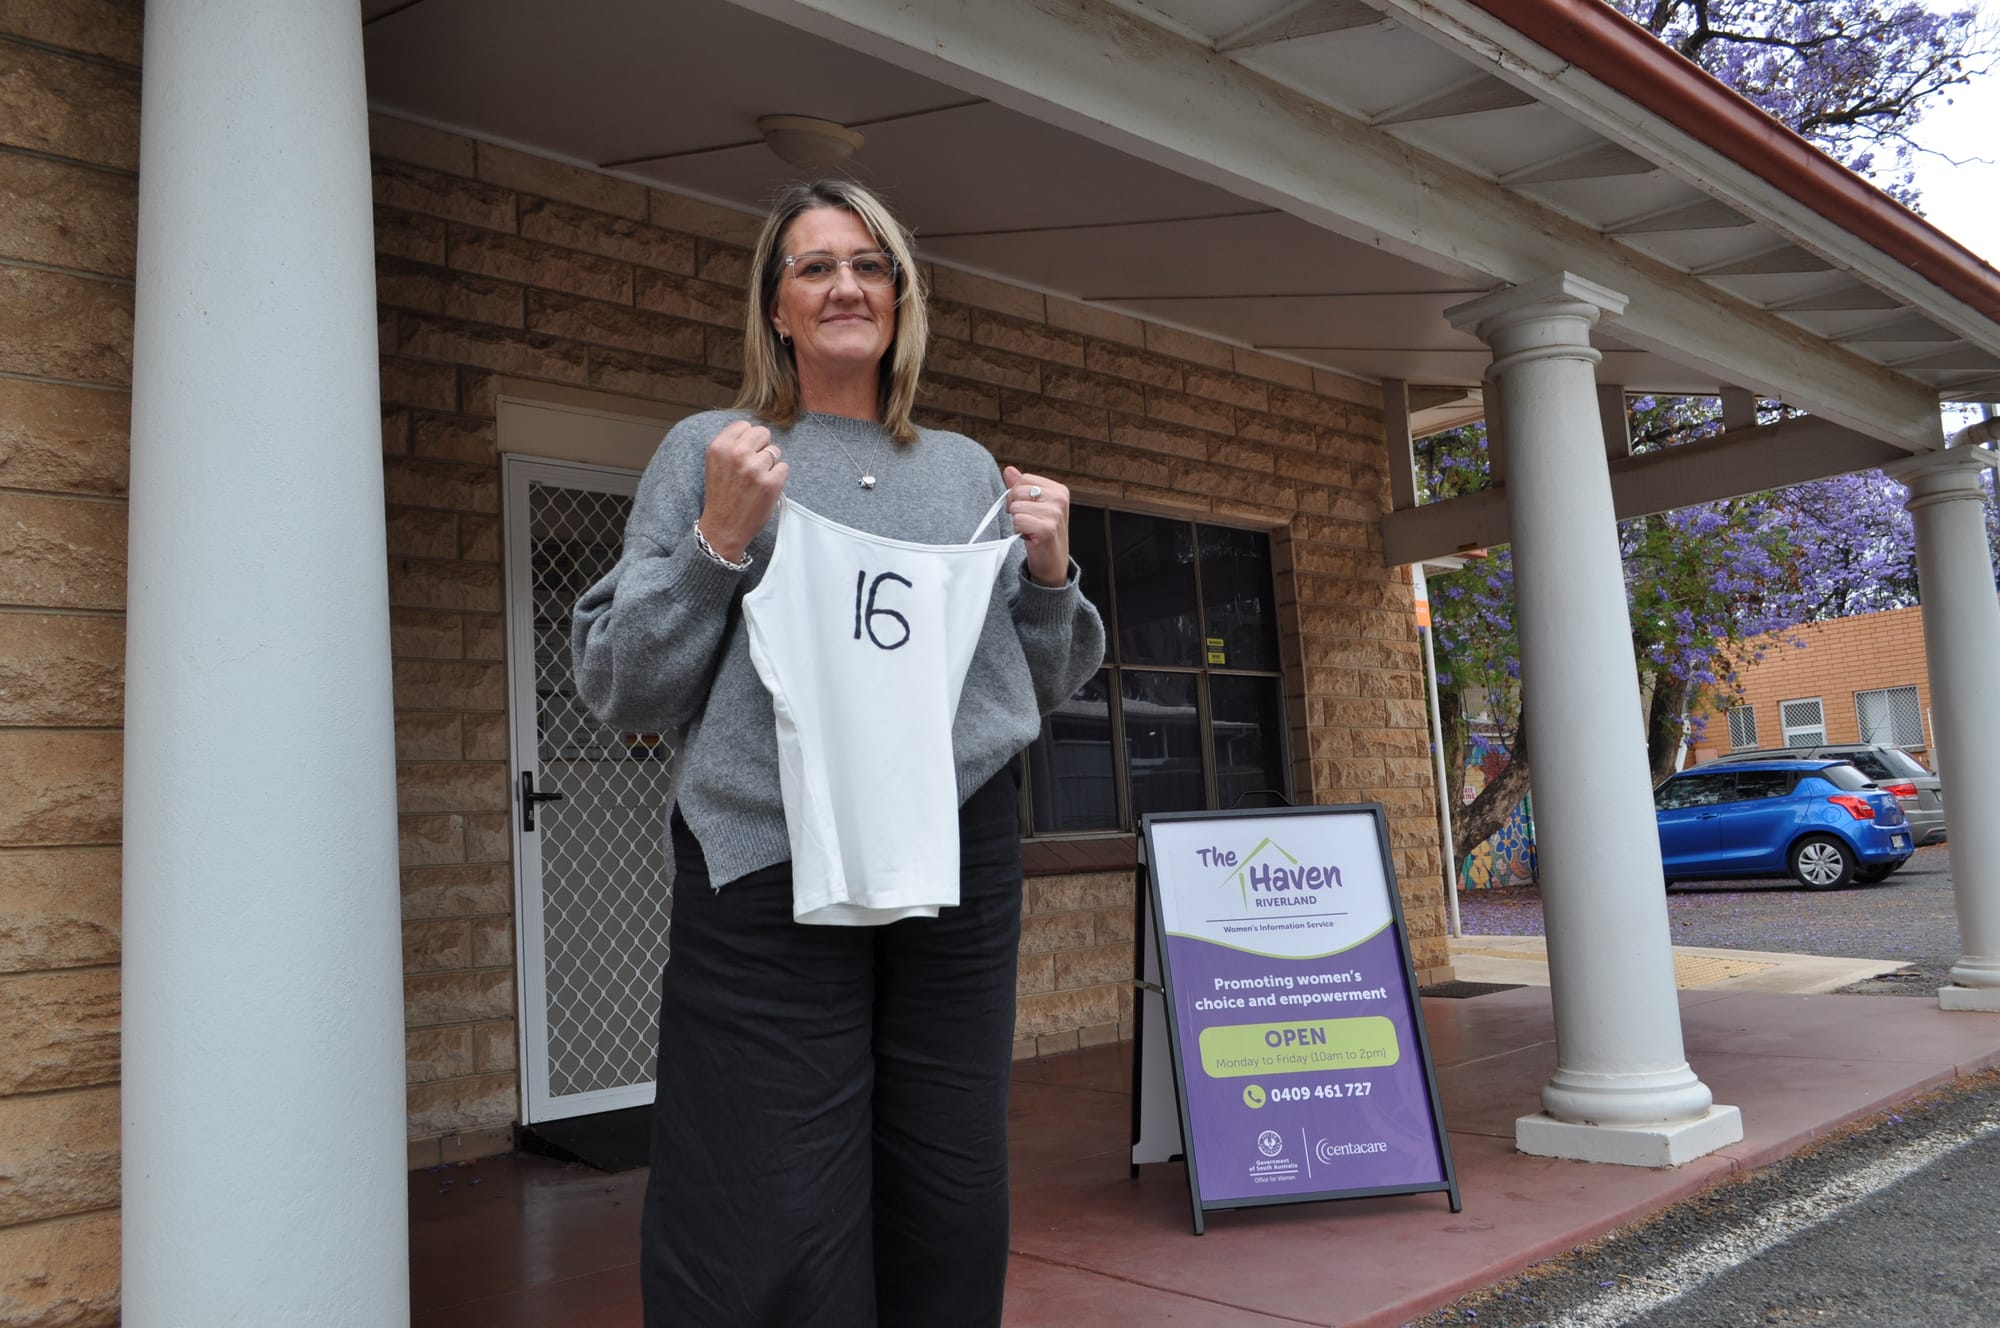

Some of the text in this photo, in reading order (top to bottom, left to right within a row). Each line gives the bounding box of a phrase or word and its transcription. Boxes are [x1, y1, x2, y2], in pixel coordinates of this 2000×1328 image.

[853, 569, 913, 650] 16
[1196, 846, 1238, 867] The
[1250, 863, 1343, 892] Haven
[1255, 895, 1317, 908] RIVERLAND
[1223, 920, 1334, 933] Women's Information Service
[1214, 969, 1362, 990] Promoting women's
[1195, 987, 1387, 1011] choice and empowerment
[1265, 1027, 1327, 1048] OPEN
[1216, 1047, 1387, 1069] Monday to Friday (10am to 2pm)
[1271, 1082, 1372, 1102] 0409 461 727
[1326, 1141, 1387, 1156] centacare
[1255, 1158, 1290, 1166] Government
[1273, 1162, 1298, 1170] Australia
[1254, 1176, 1268, 1184] Office
